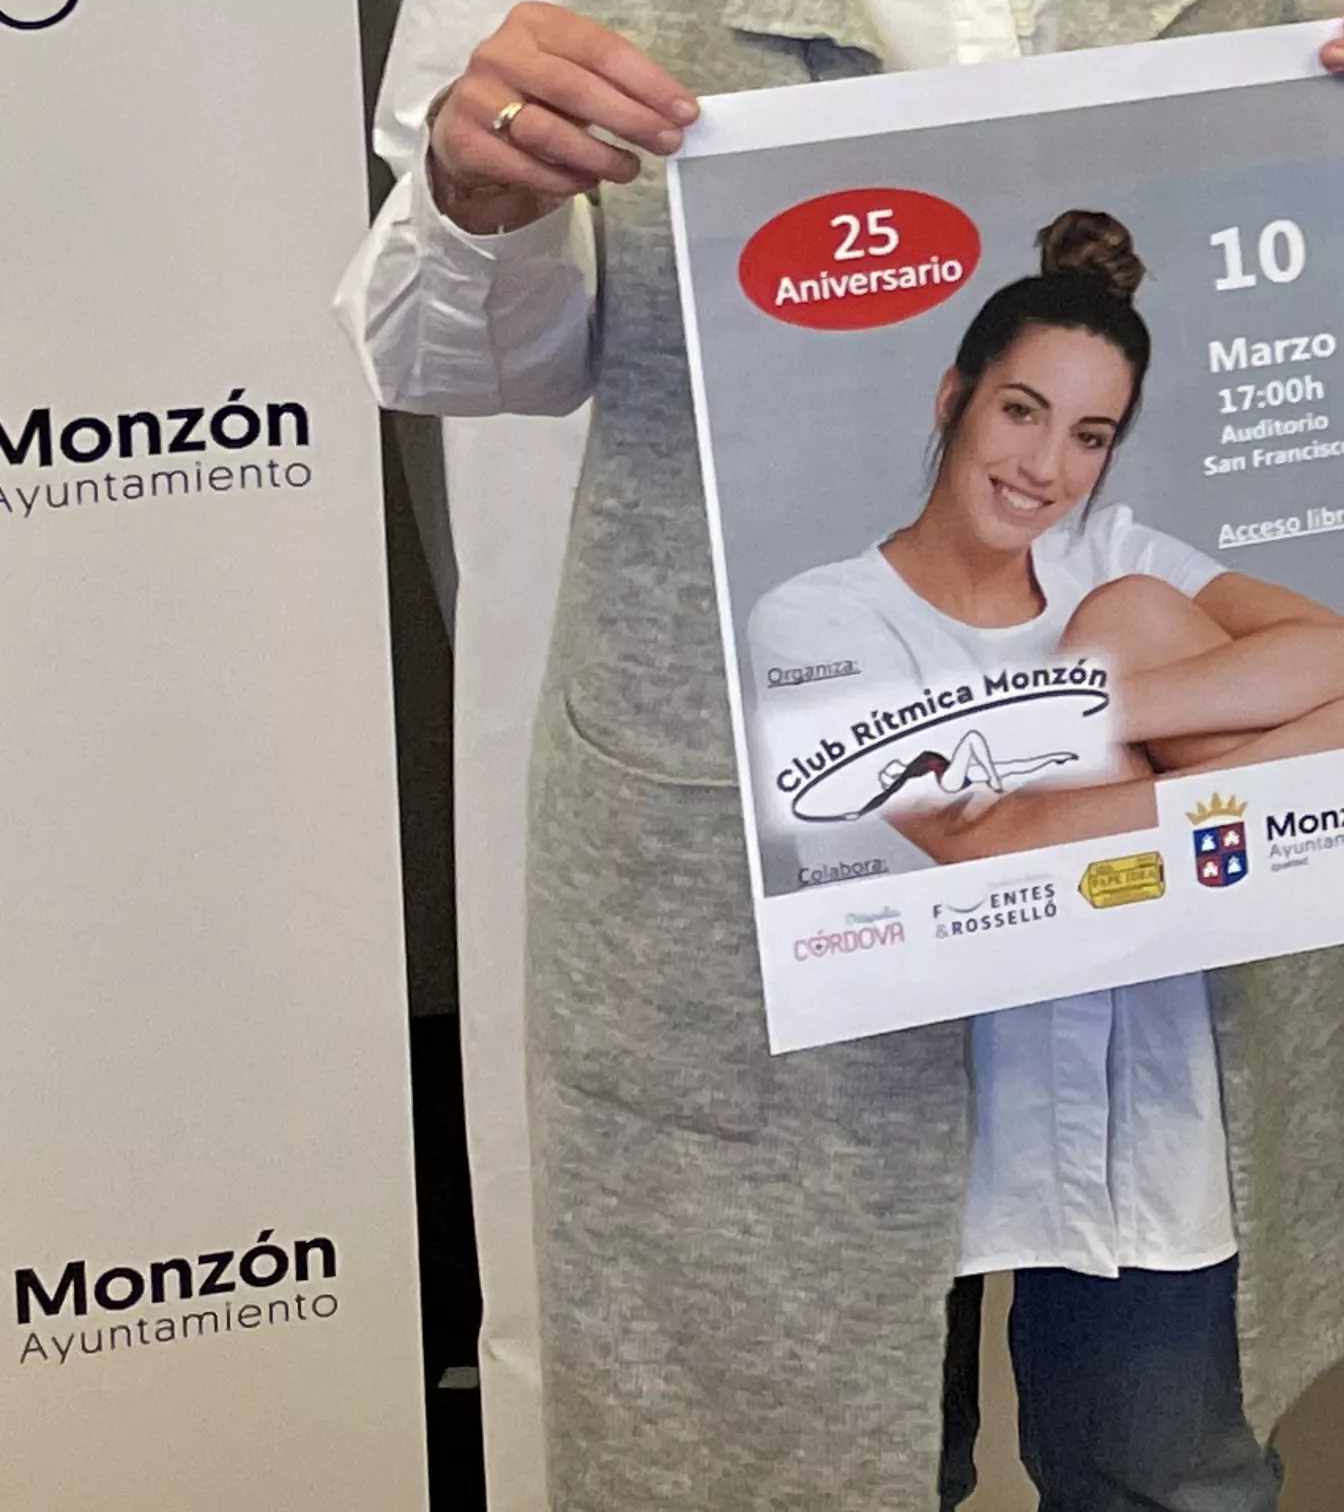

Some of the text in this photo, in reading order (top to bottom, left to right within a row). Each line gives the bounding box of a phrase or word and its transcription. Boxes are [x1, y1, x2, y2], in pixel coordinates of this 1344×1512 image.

[830, 209, 900, 261] 25
[1210, 219, 1306, 291] 10
[775, 256, 964, 307] Aniversario
[1208, 333, 1337, 373] Marzo
[1218, 375, 1325, 414] 17:00h
[0, 388, 310, 467] Monzón
[1221, 414, 1329, 444] Auditorio
[1203, 455, 1246, 476] San
[1218, 518, 1301, 546] Acceso
[776, 658, 1107, 794] Club Rítmica Monzón
[15, 1228, 337, 1325] Monzón
[20, 1292, 338, 1365] Ayuntamiento
